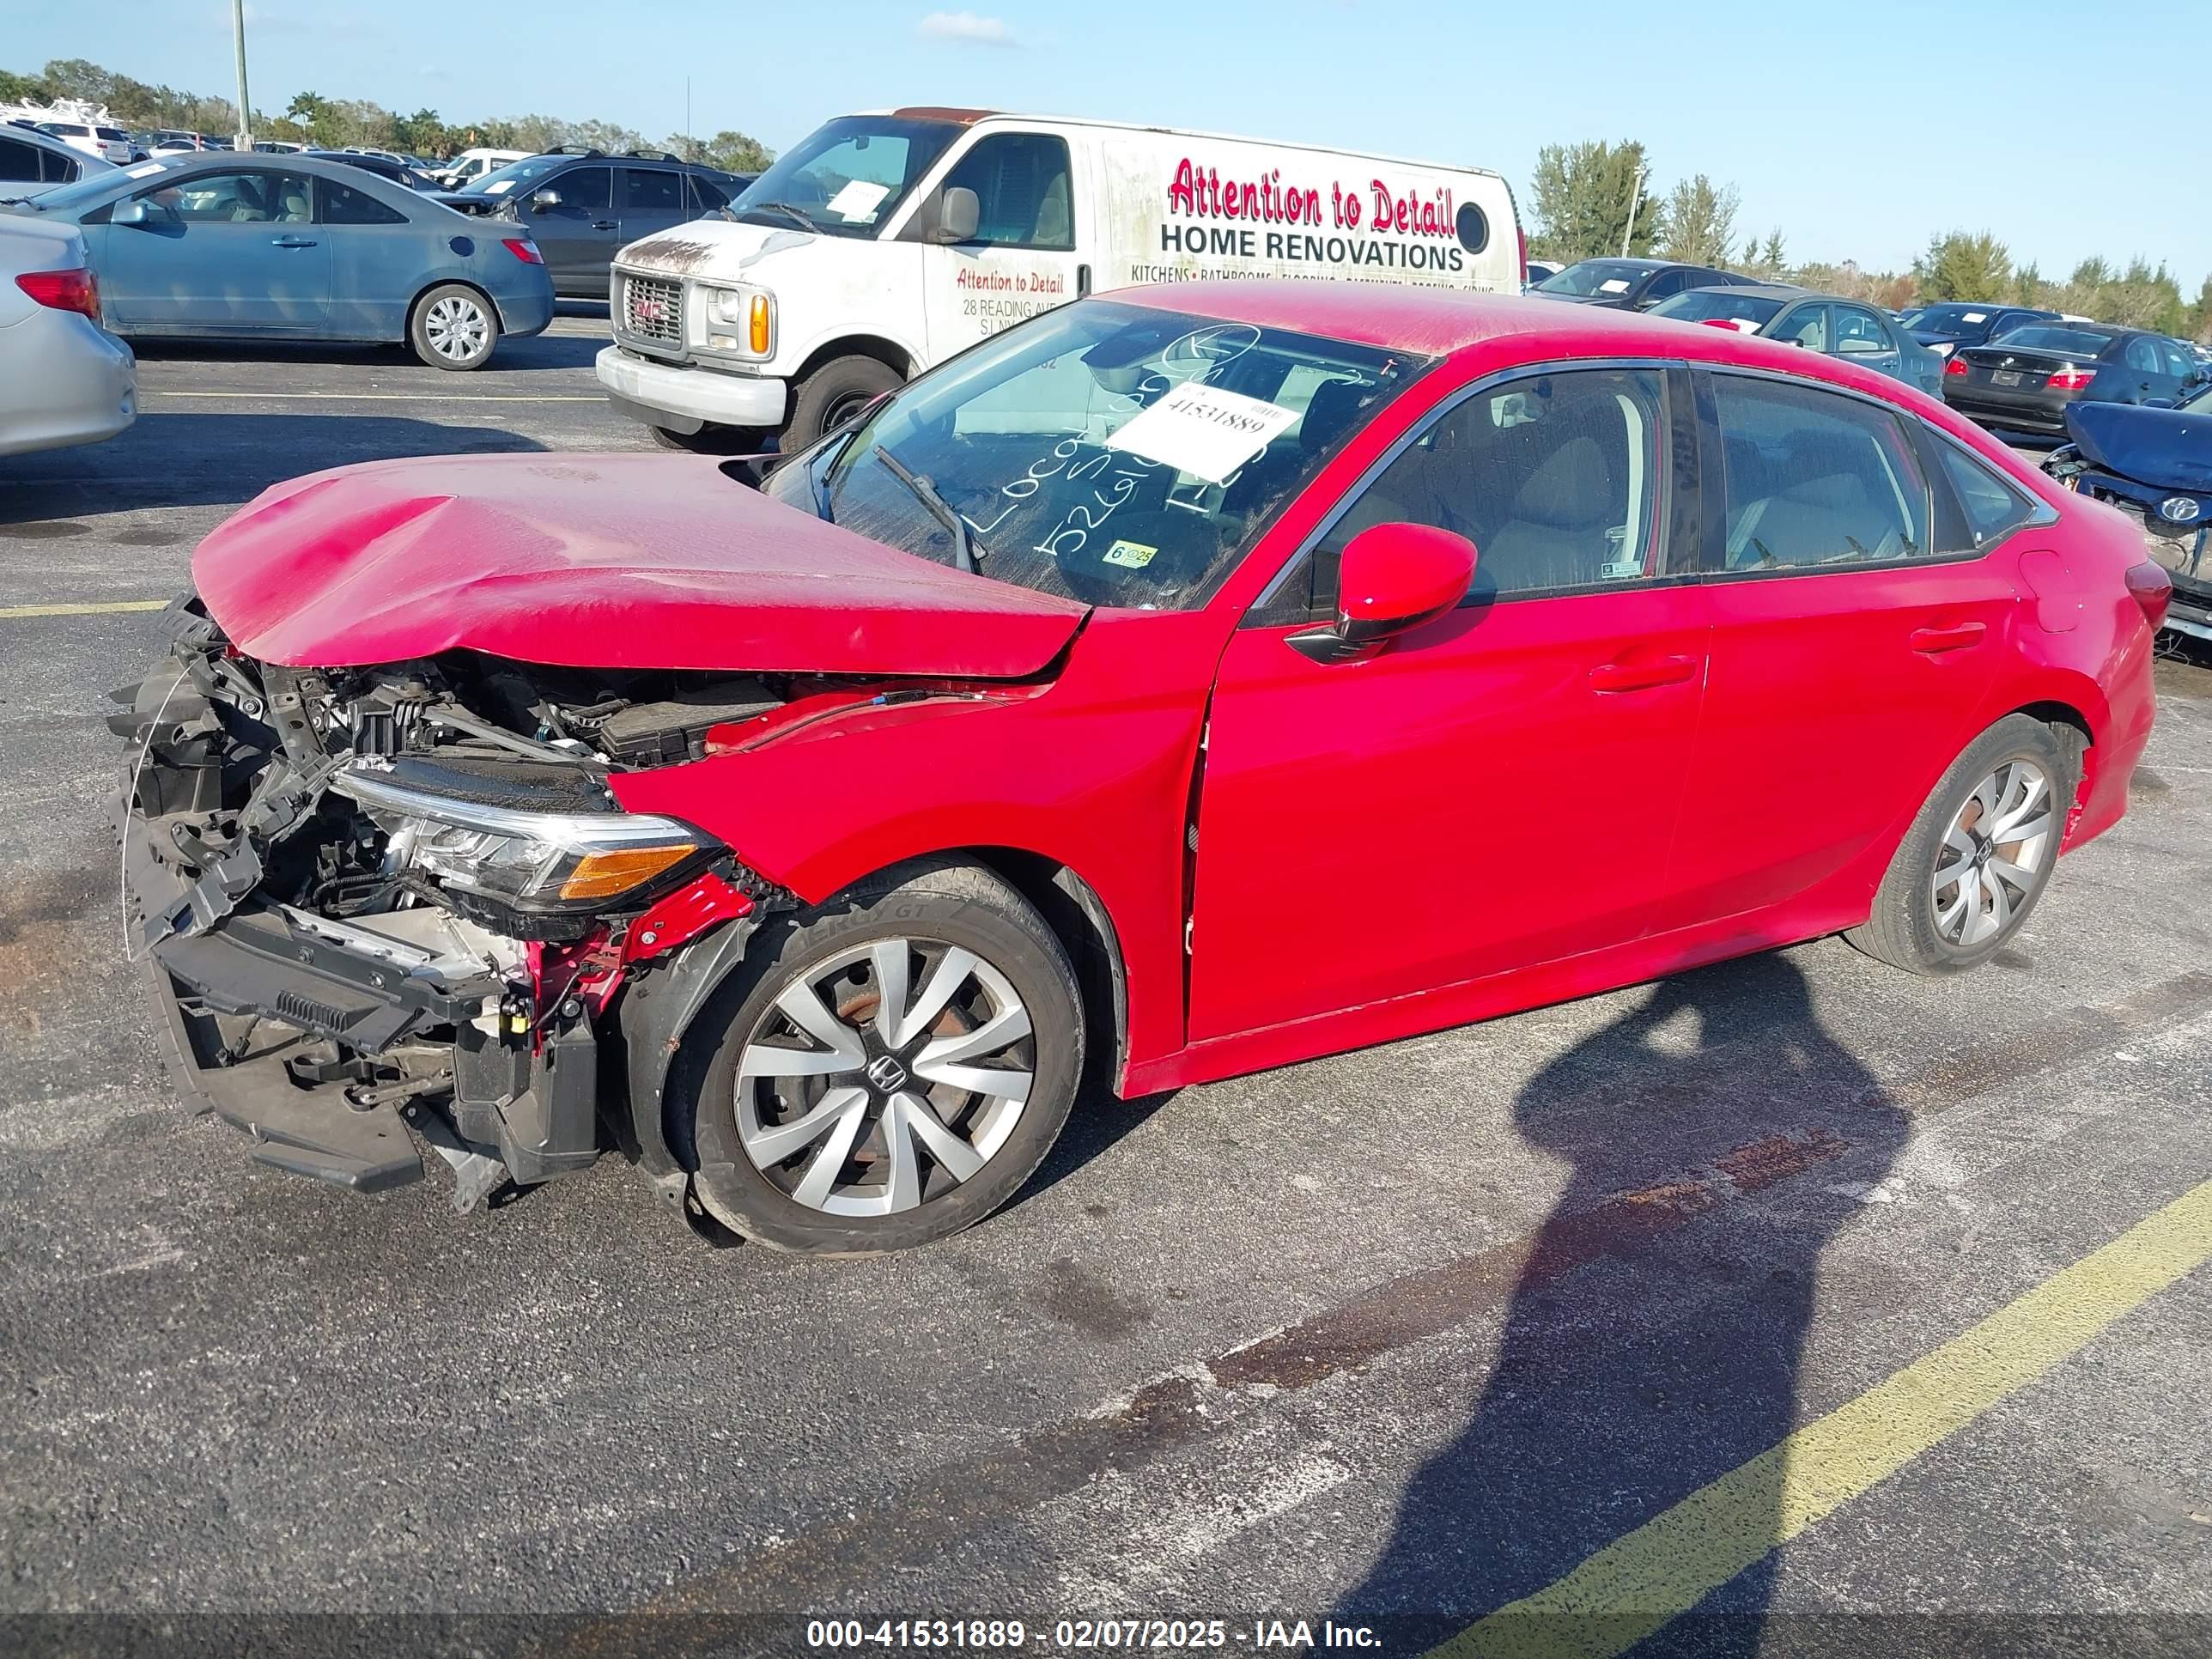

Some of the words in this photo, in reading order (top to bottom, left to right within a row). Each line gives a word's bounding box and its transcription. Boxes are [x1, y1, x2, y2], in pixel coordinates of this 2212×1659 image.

[1168, 157, 1323, 228] Attention
[1333, 180, 1362, 229] to
[1370, 179, 1457, 239] Detail
[1161, 223, 1256, 257] HOME
[1266, 232, 1464, 272] RENOVATIONS
[957, 268, 1012, 291] Attention
[1016, 275, 1027, 291] to
[1030, 272, 1064, 294] Detail
[1132, 264, 1189, 283] KITCHENS
[636, 302, 661, 319] GMC
[963, 299, 977, 315] 28
[980, 299, 1031, 318] READING
[1169, 399, 1265, 433] 41531889
[1112, 546, 1126, 559] 6
[1136, 550, 1152, 562] 25
